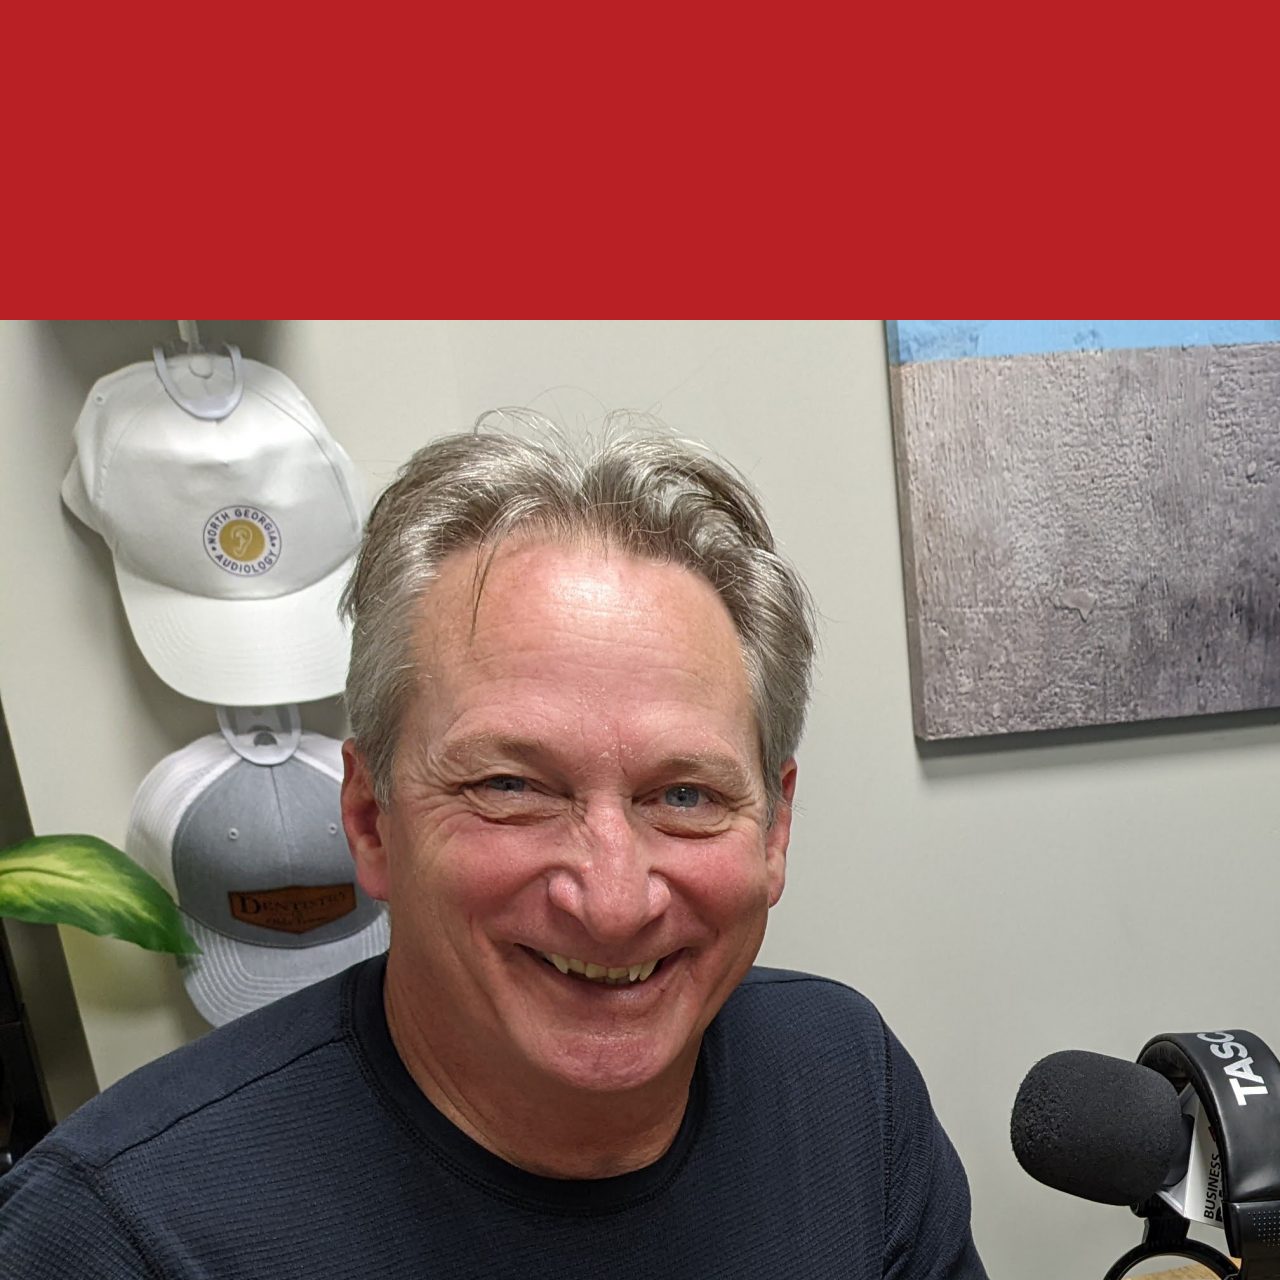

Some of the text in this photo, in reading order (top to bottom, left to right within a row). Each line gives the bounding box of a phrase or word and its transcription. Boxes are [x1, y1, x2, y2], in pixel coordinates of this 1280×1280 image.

[207, 508, 278, 545] NORTH GEORGIA
[215, 550, 277, 574] AUDIOLOGY
[1204, 1153, 1221, 1220] BUSINESS
